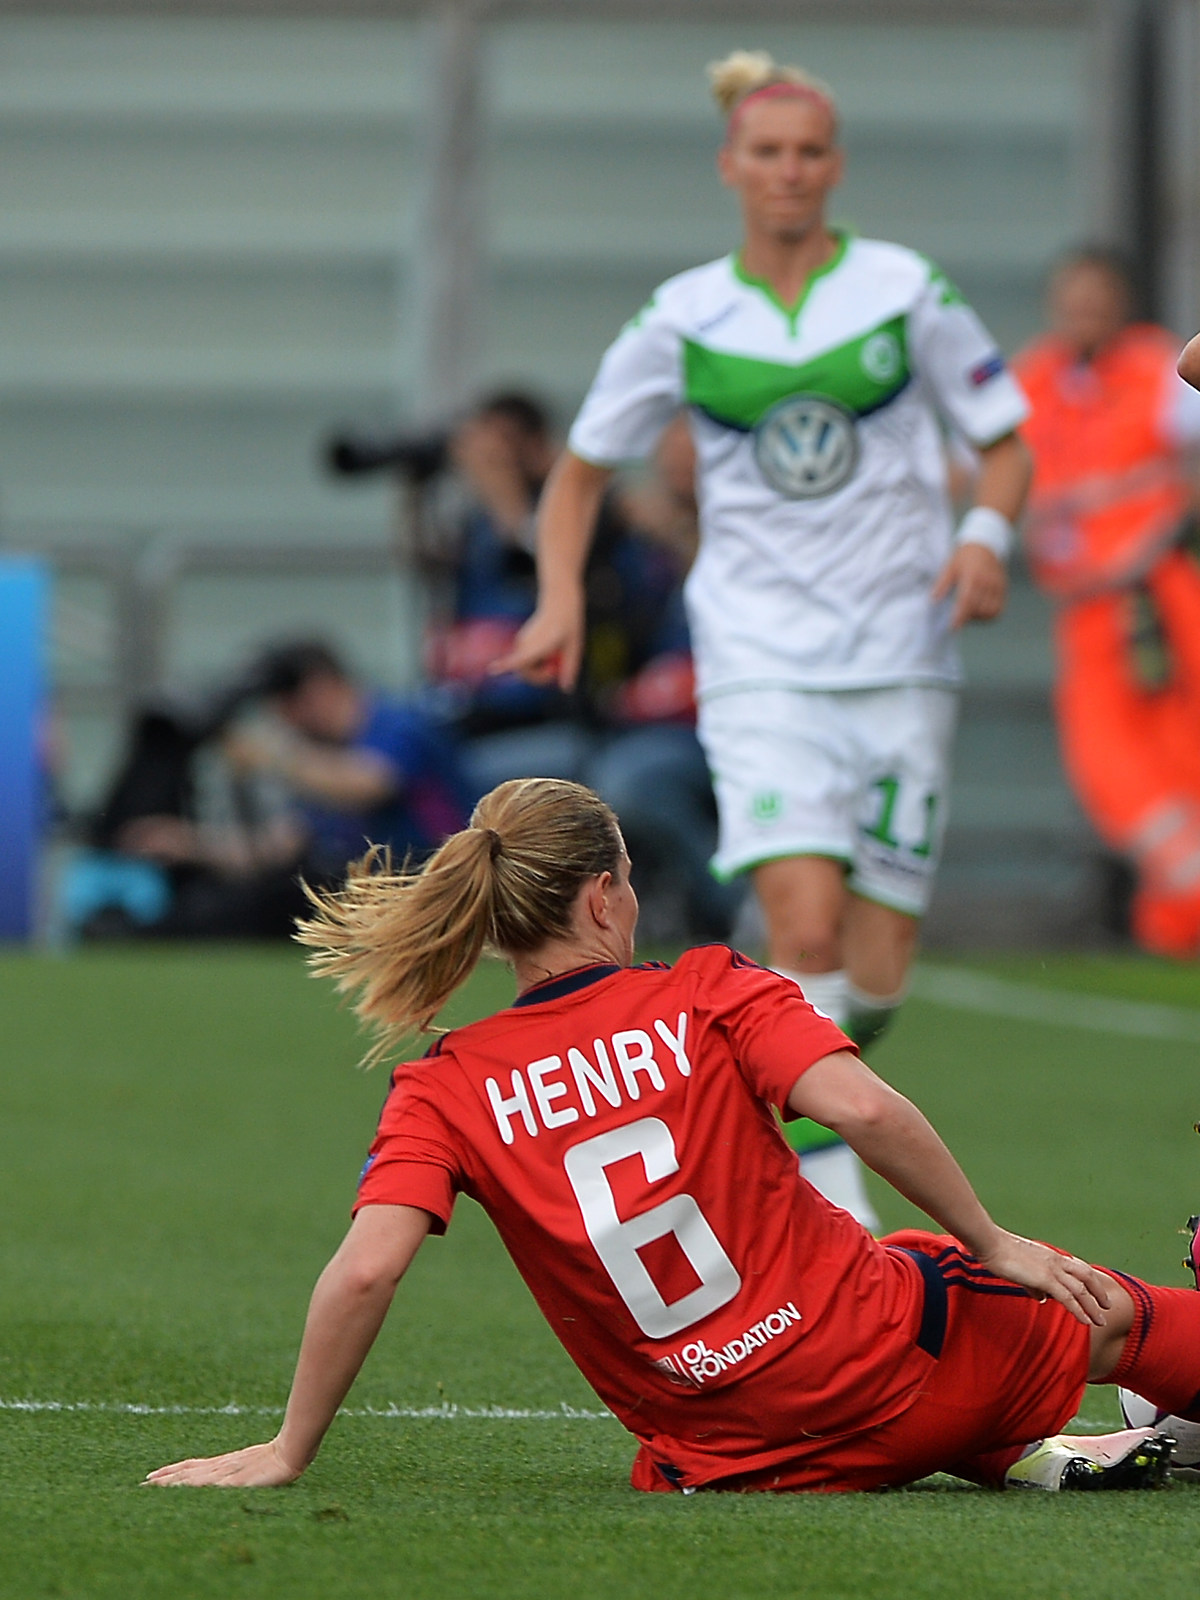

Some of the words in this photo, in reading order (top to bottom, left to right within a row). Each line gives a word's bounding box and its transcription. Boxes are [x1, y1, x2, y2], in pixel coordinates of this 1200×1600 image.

[485, 1011, 691, 1145] HENRY
[564, 1116, 742, 1339] 6
[681, 1339, 713, 1365] OL
[689, 1301, 802, 1383] FONDATION
